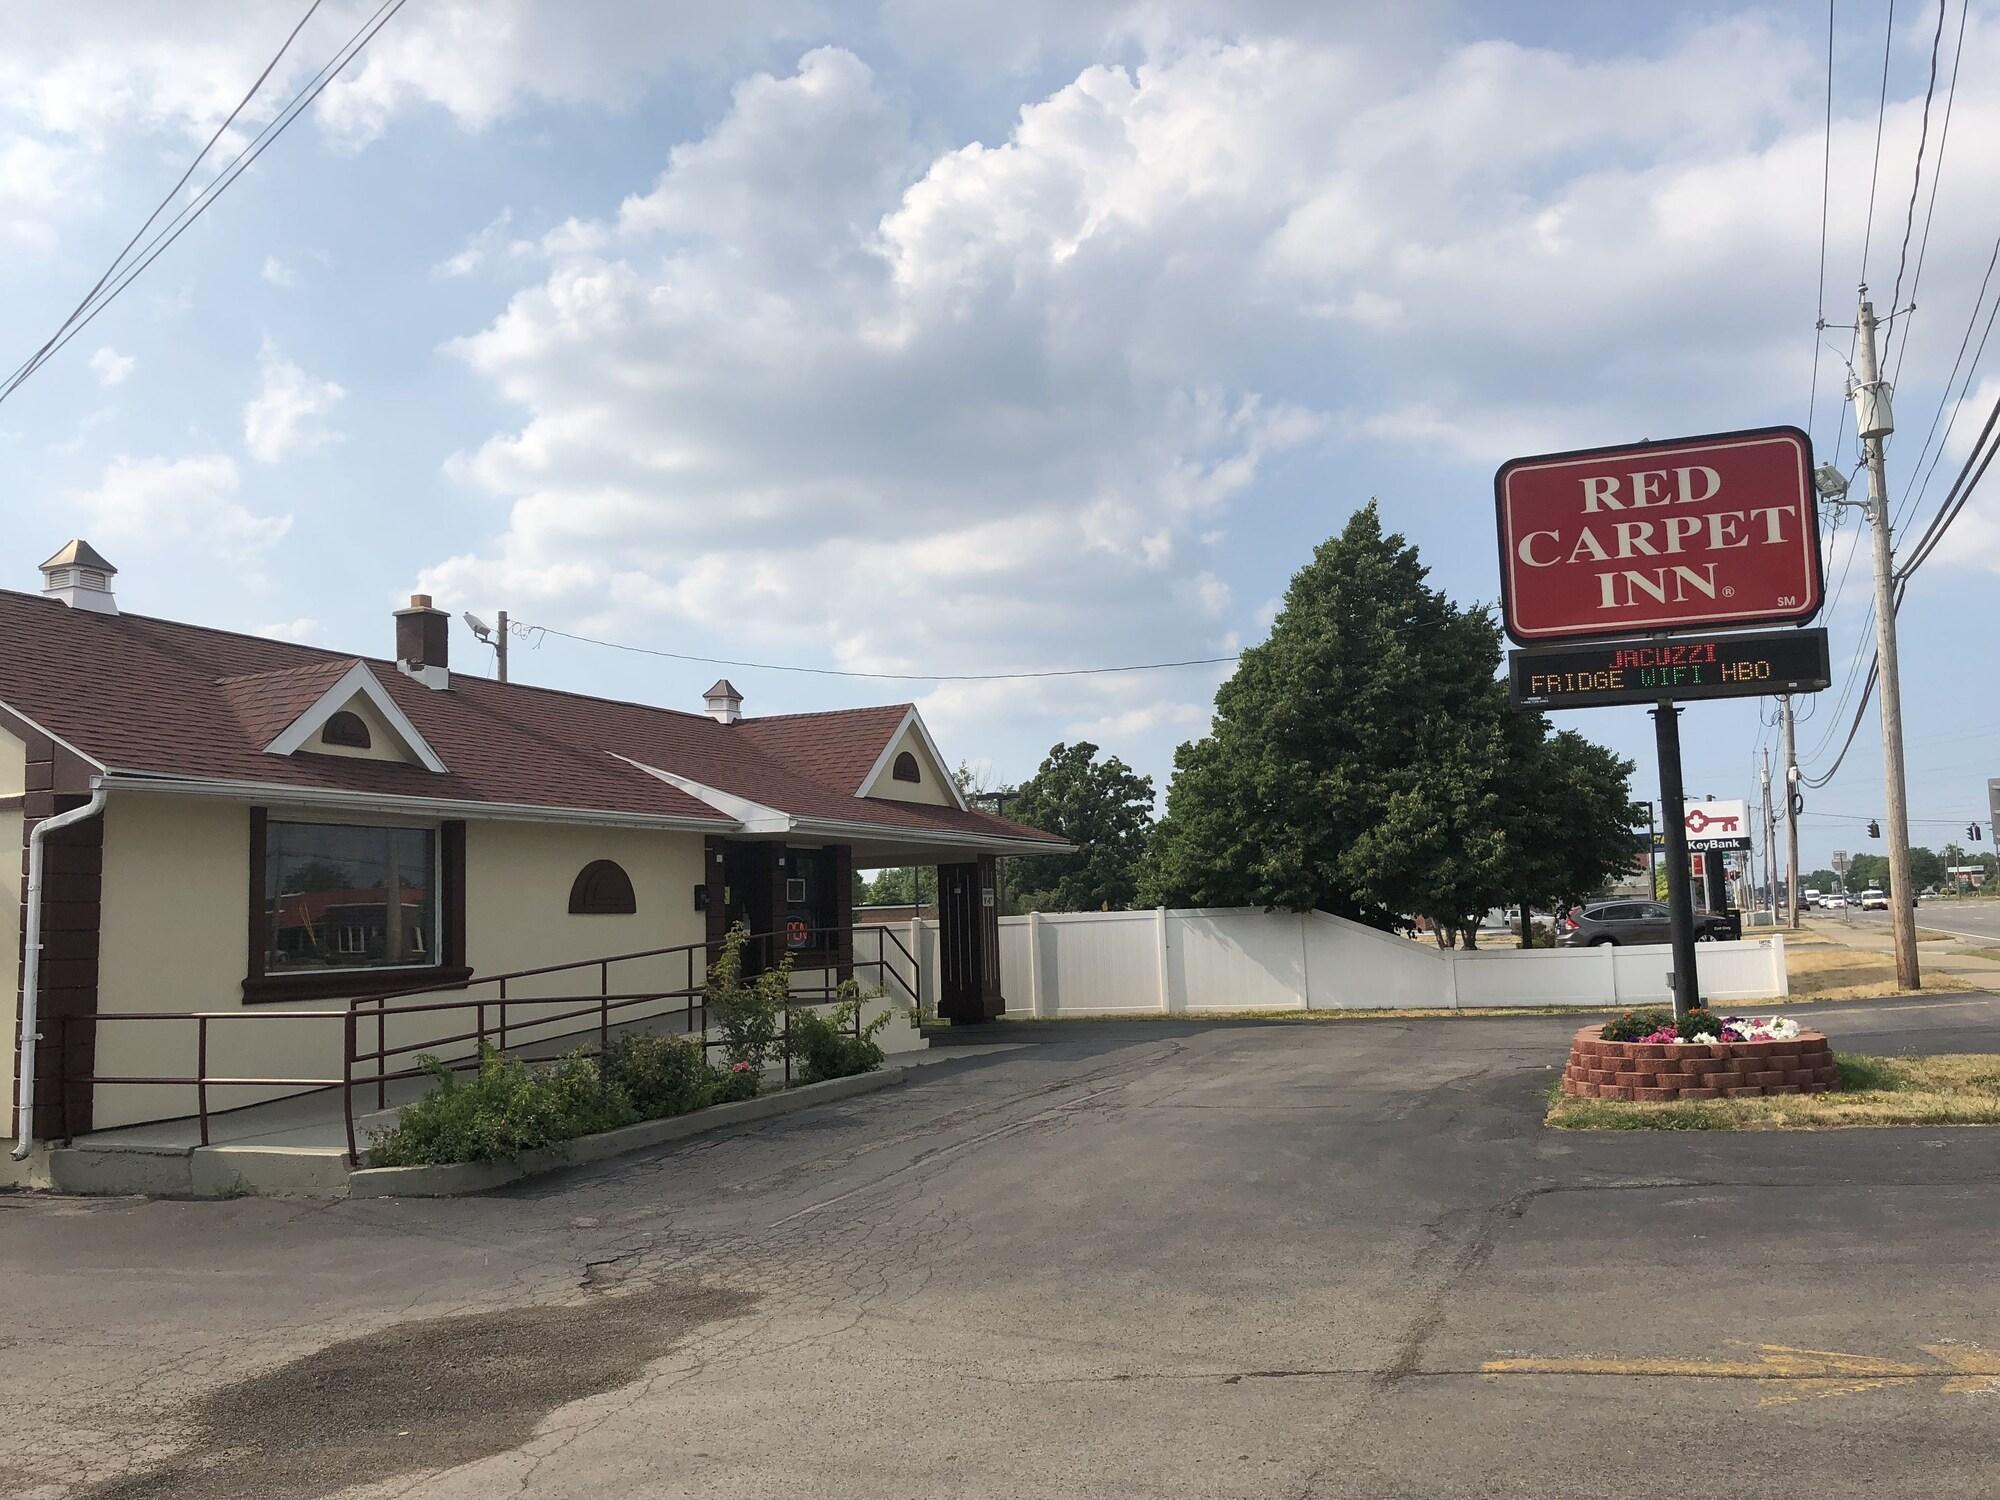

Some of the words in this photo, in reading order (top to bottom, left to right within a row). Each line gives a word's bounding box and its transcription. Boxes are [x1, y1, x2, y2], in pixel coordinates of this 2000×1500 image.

[1578, 465, 1721, 514] RED
[1518, 505, 1795, 568] CARPET
[1777, 595, 1796, 607] SM
[1609, 643, 1717, 668] JACUZZI
[1531, 669, 1625, 693] FRIDGE
[1641, 665, 1702, 687] WIFI
[1721, 660, 1770, 682] HBO
[1687, 838, 1740, 851] KeyBank
[786, 921, 808, 941] PEN
